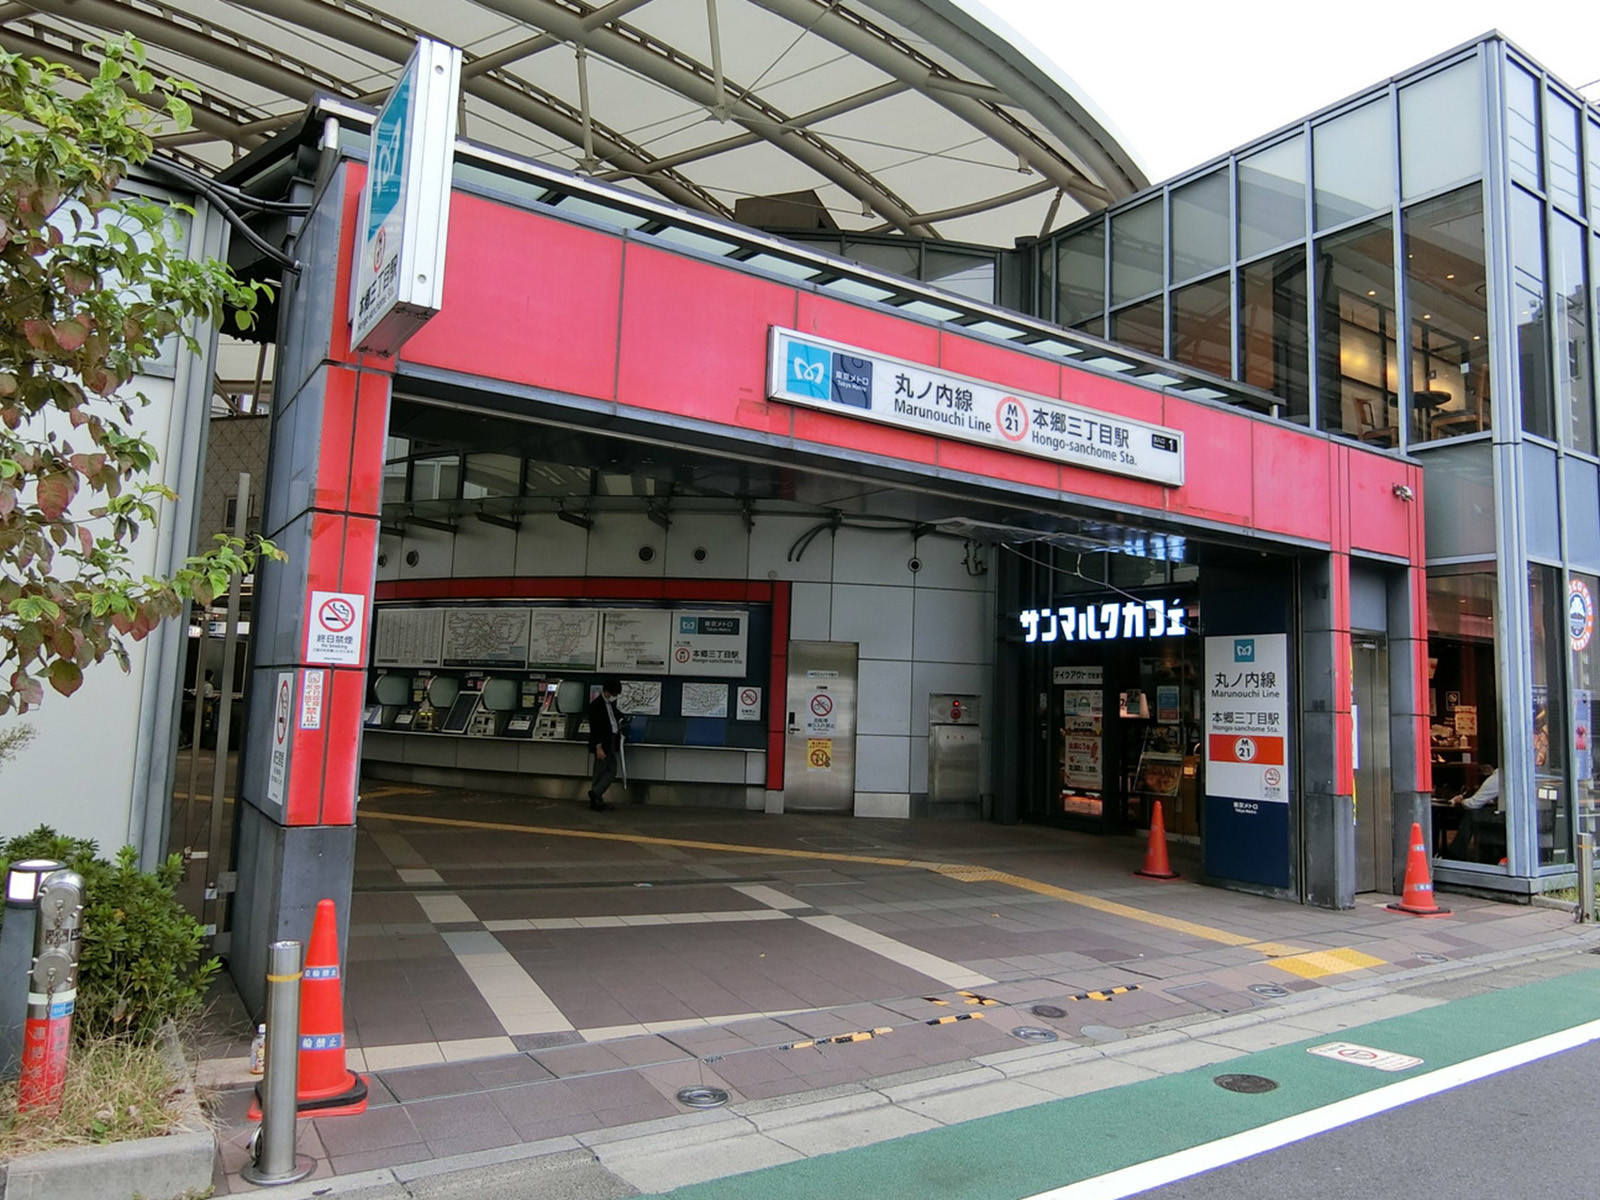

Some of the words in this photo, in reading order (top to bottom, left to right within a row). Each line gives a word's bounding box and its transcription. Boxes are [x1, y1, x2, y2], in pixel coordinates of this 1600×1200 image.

[835, 370, 869, 387] 東京メトロ
[837, 380, 851, 390] Tokyo
[895, 373, 973, 412] 丸ノ内線
[894, 399, 965, 427] Marunouchi
[968, 415, 992, 434] Line
[1007, 404, 1018, 417] M
[1005, 417, 1019, 432] 21
[1032, 407, 1130, 449] 本郷三丁目駅
[1032, 430, 1117, 461] Hongo-sanchome
[1120, 451, 1138, 466] Sta.
[1169, 439, 1174, 451] 1
[1019, 599, 1188, 643] サンマルクカフェ
[317, 634, 353, 644] 終日禁煙
[692, 650, 739, 658] 本郷三丁目駅
[1215, 671, 1276, 688] 丸ノ内線
[1211, 689, 1260, 698] Marunouchi
[1262, 689, 1280, 698] Line
[1212, 711, 1280, 725] 本郷三丁目駅
[1238, 747, 1250, 757] 21
[1233, 801, 1258, 810] 東京メトロ
